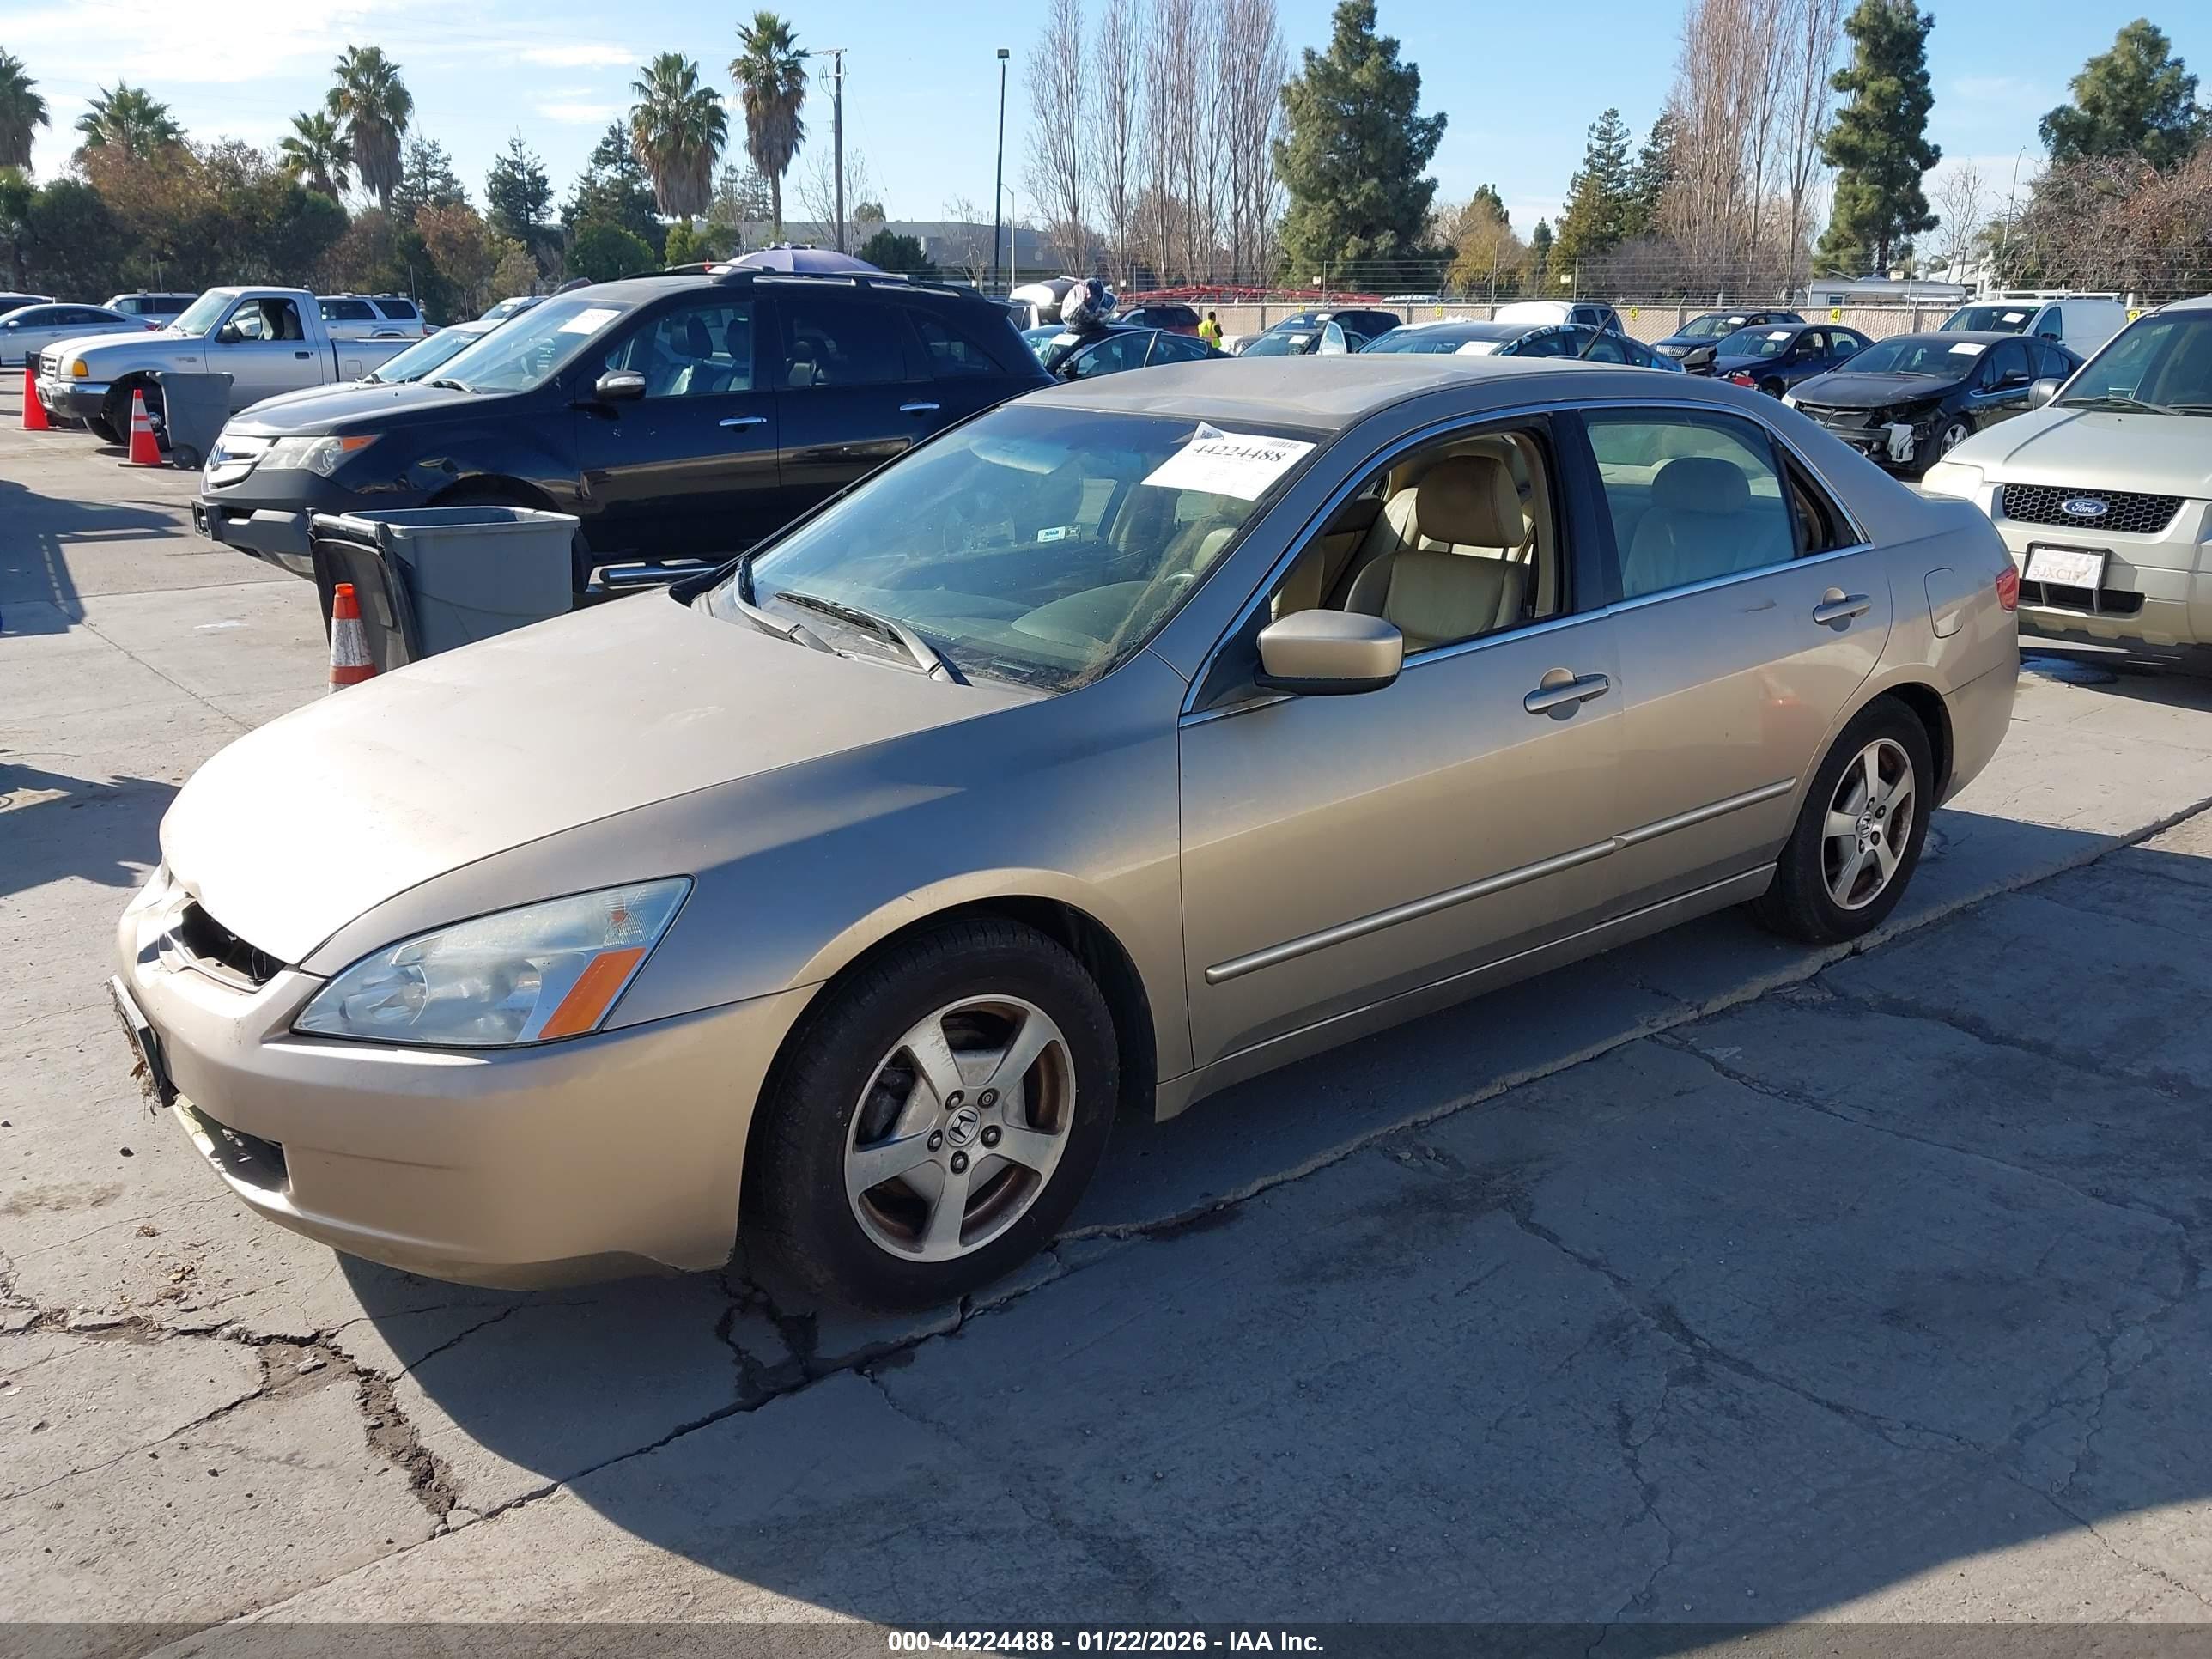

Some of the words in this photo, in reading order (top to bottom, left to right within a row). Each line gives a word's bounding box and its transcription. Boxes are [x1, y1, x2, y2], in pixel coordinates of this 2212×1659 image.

[1832, 309, 1838, 320] 4
[1194, 443, 1286, 462] 44224488
[2071, 501, 2098, 514] Ford
